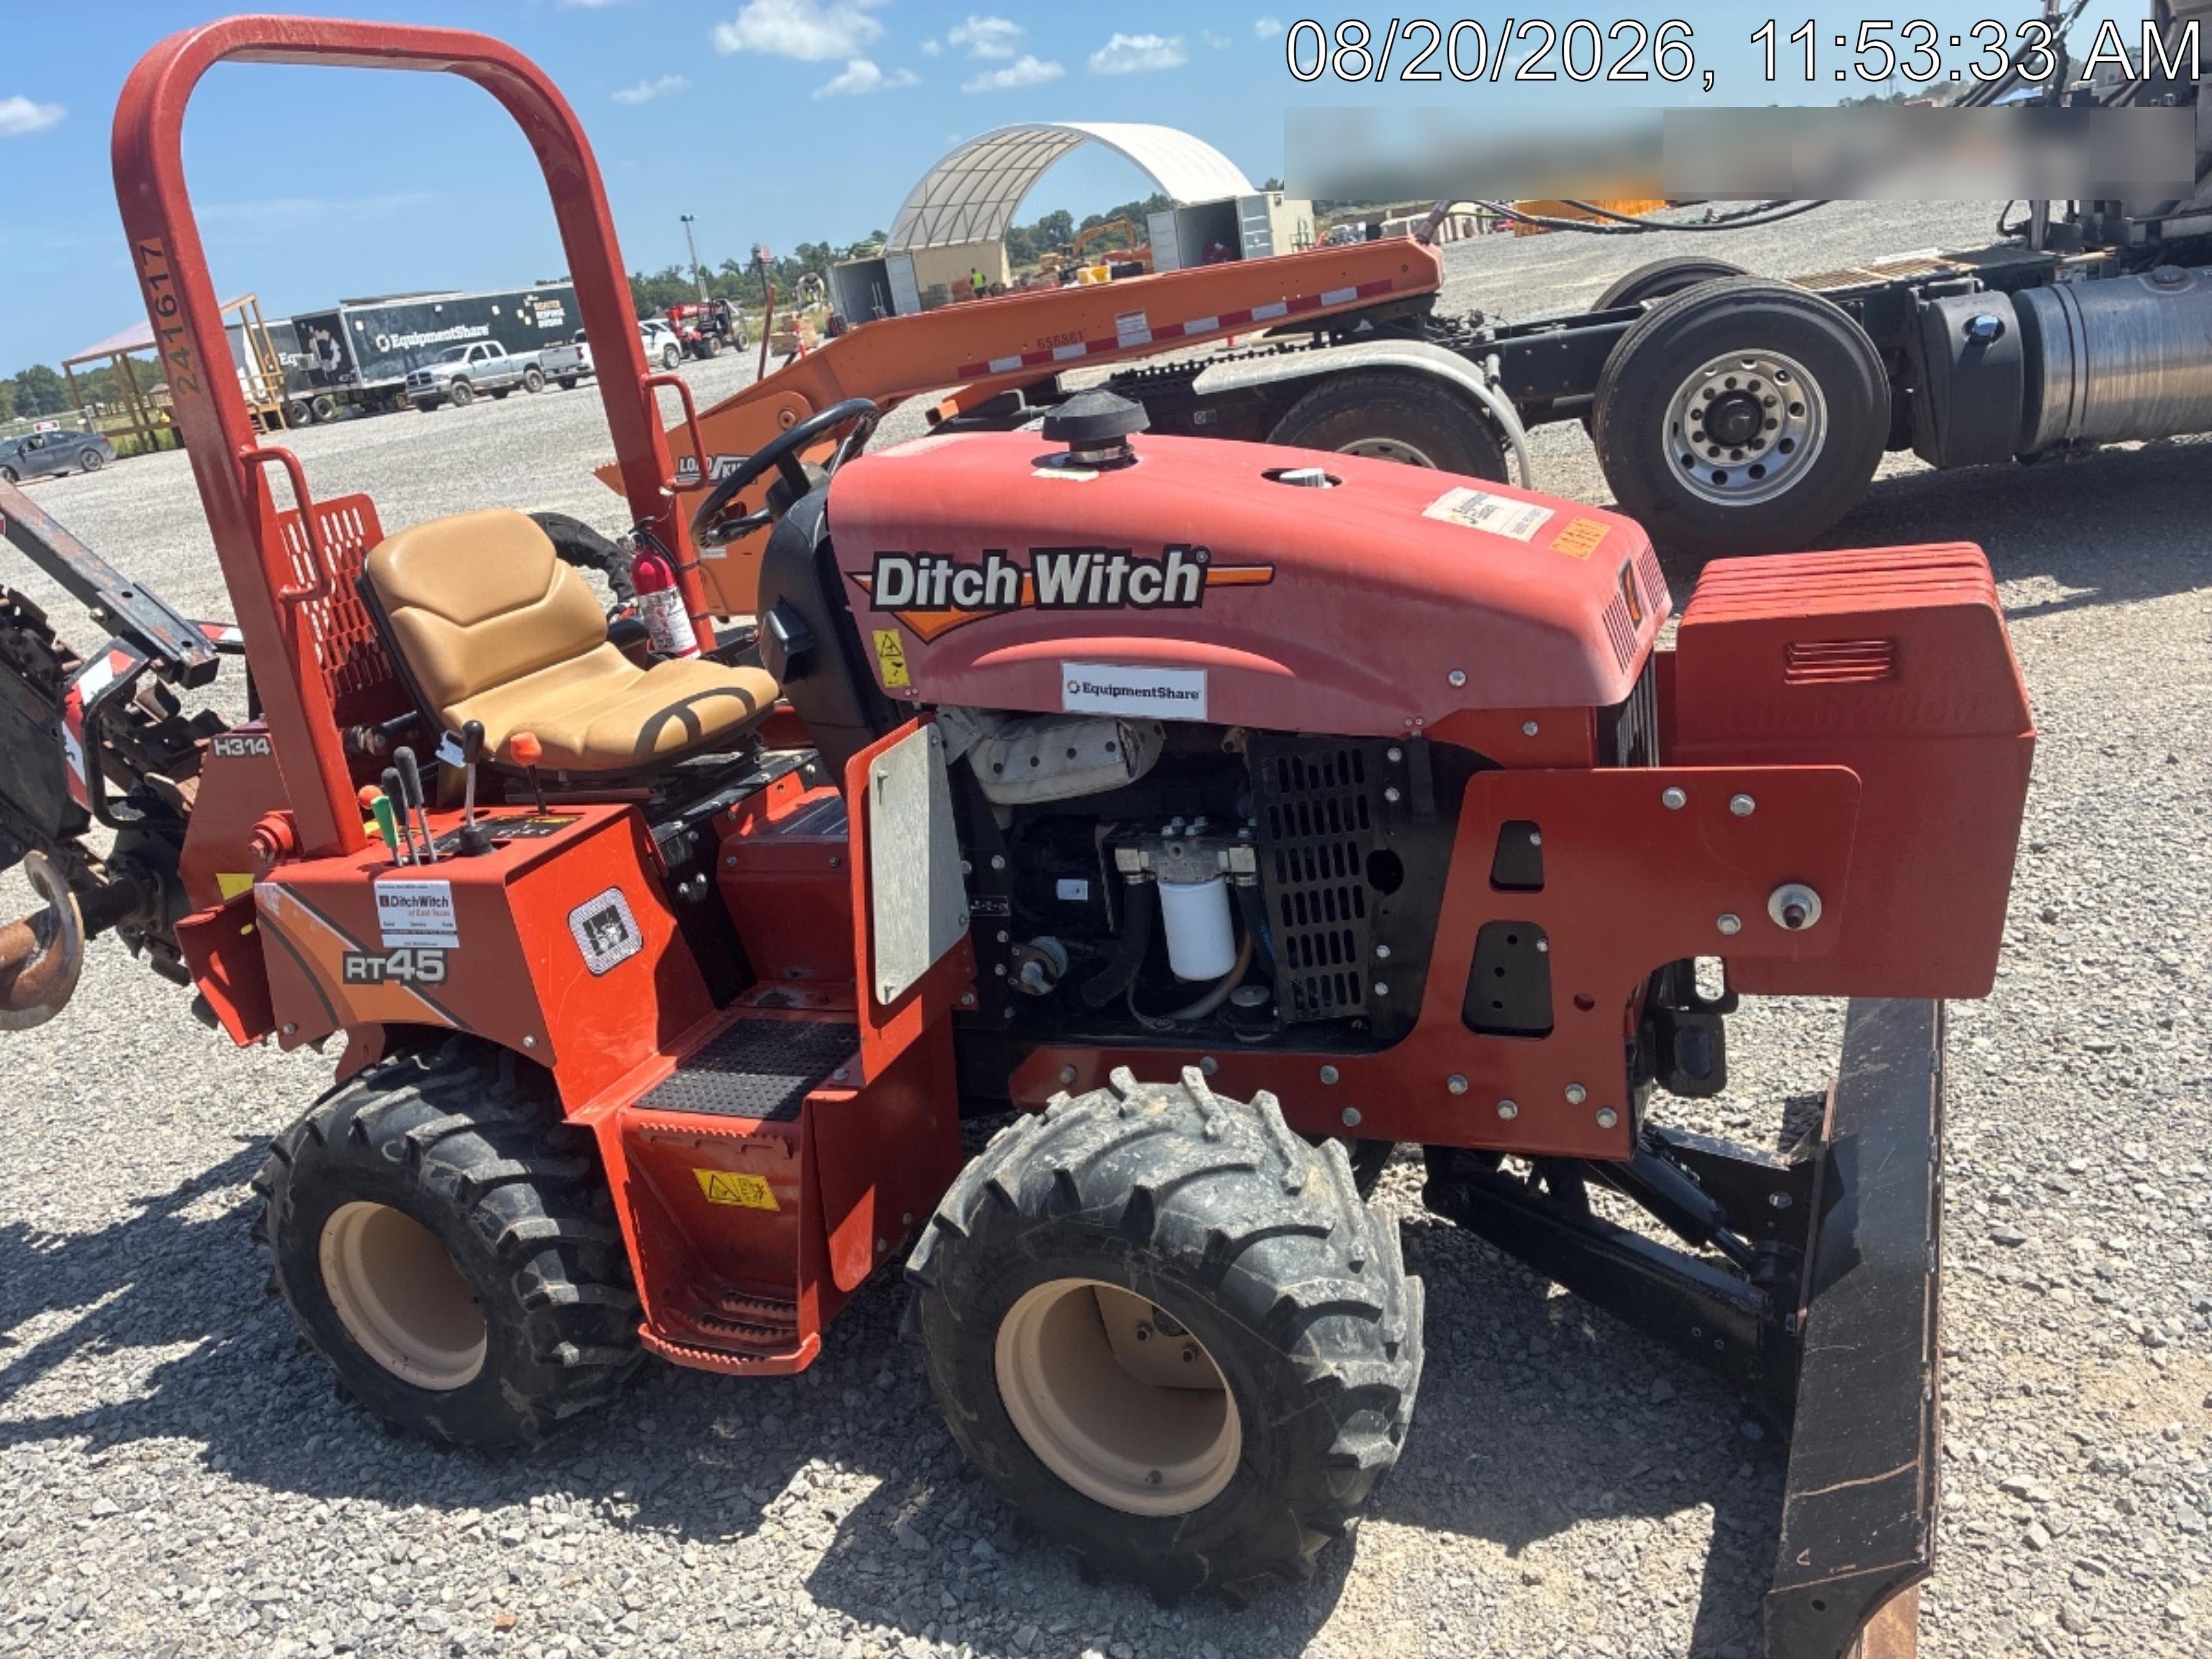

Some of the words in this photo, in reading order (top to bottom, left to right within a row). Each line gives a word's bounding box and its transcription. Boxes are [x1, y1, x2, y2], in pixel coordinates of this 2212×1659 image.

[139, 244, 202, 395] 241617
[390, 323, 490, 350] EquipmentShare
[875, 553, 1018, 606] Ditch
[1083, 682, 1199, 700] EquipmentShare
[213, 738, 270, 756] H314
[346, 949, 445, 981] RT45
